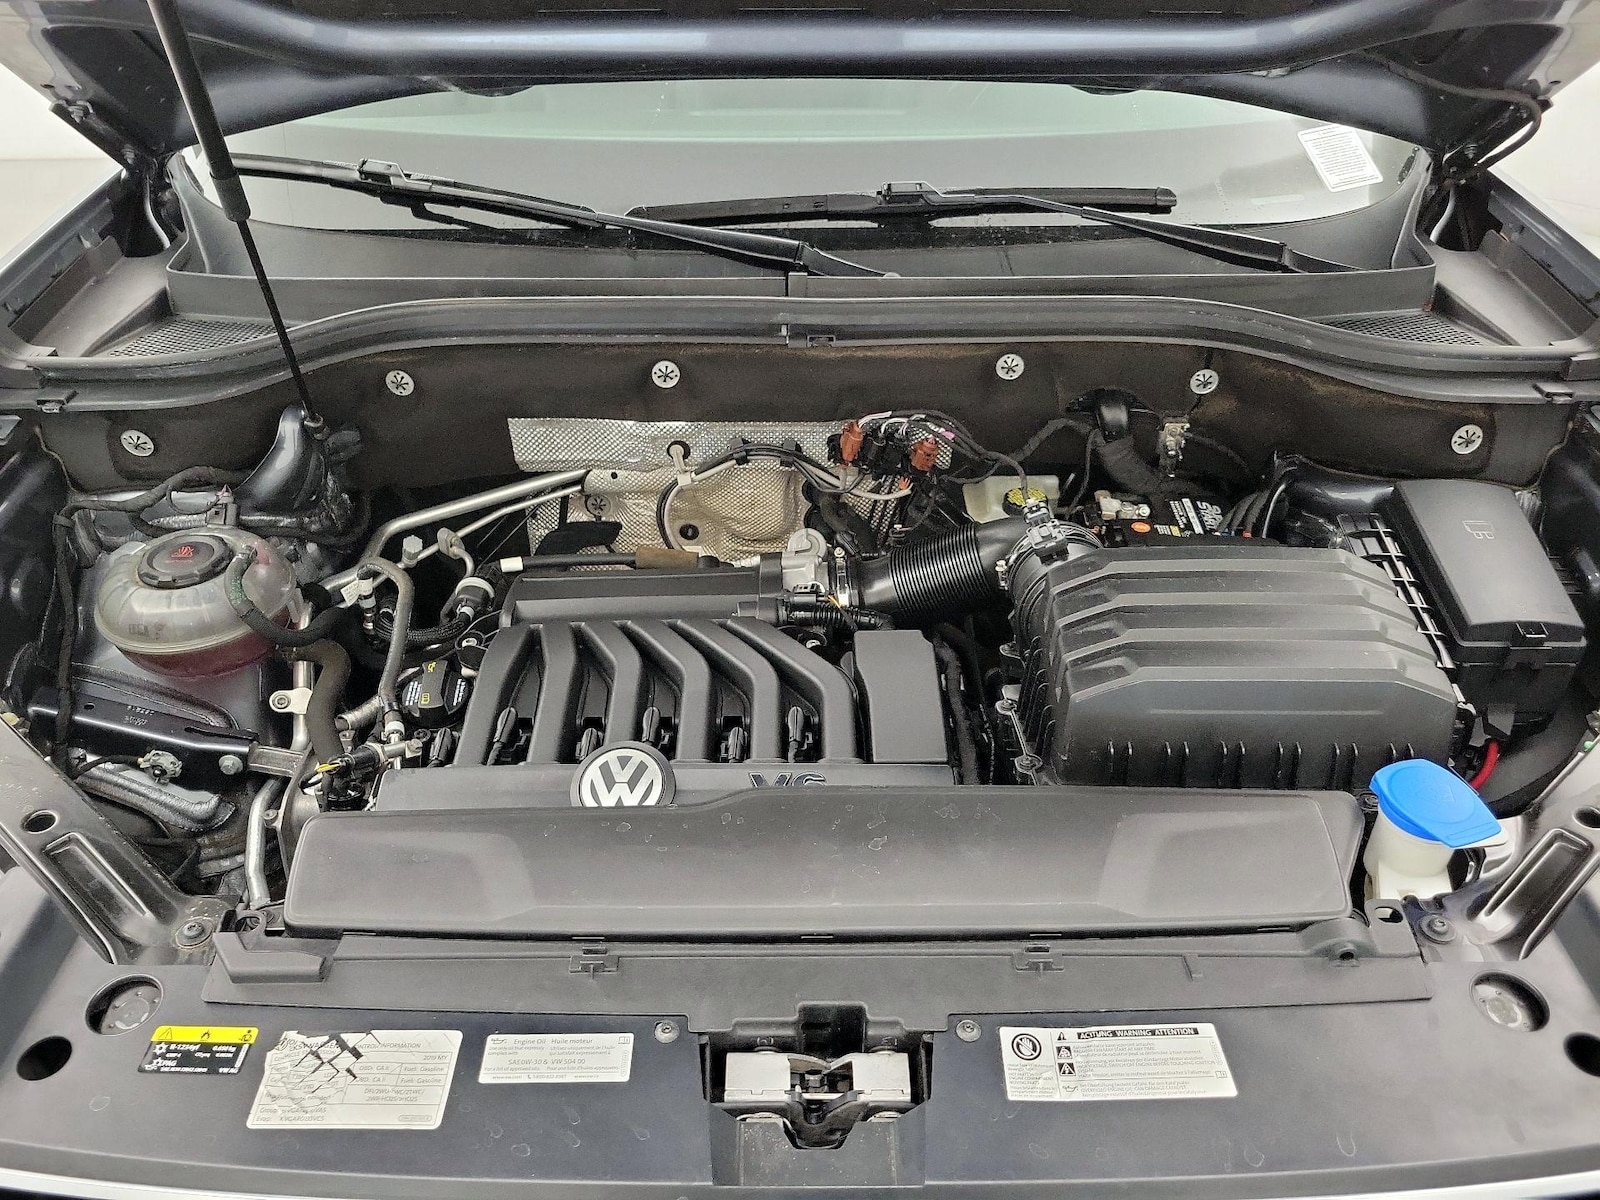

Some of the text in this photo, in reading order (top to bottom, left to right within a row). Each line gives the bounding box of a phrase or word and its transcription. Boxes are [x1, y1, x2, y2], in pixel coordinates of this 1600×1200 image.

[582, 749, 663, 807] VW
[1115, 1029, 1152, 1037] WARNING
[1155, 1028, 1195, 1036] ATTENTION
[513, 1038, 536, 1046] Engine
